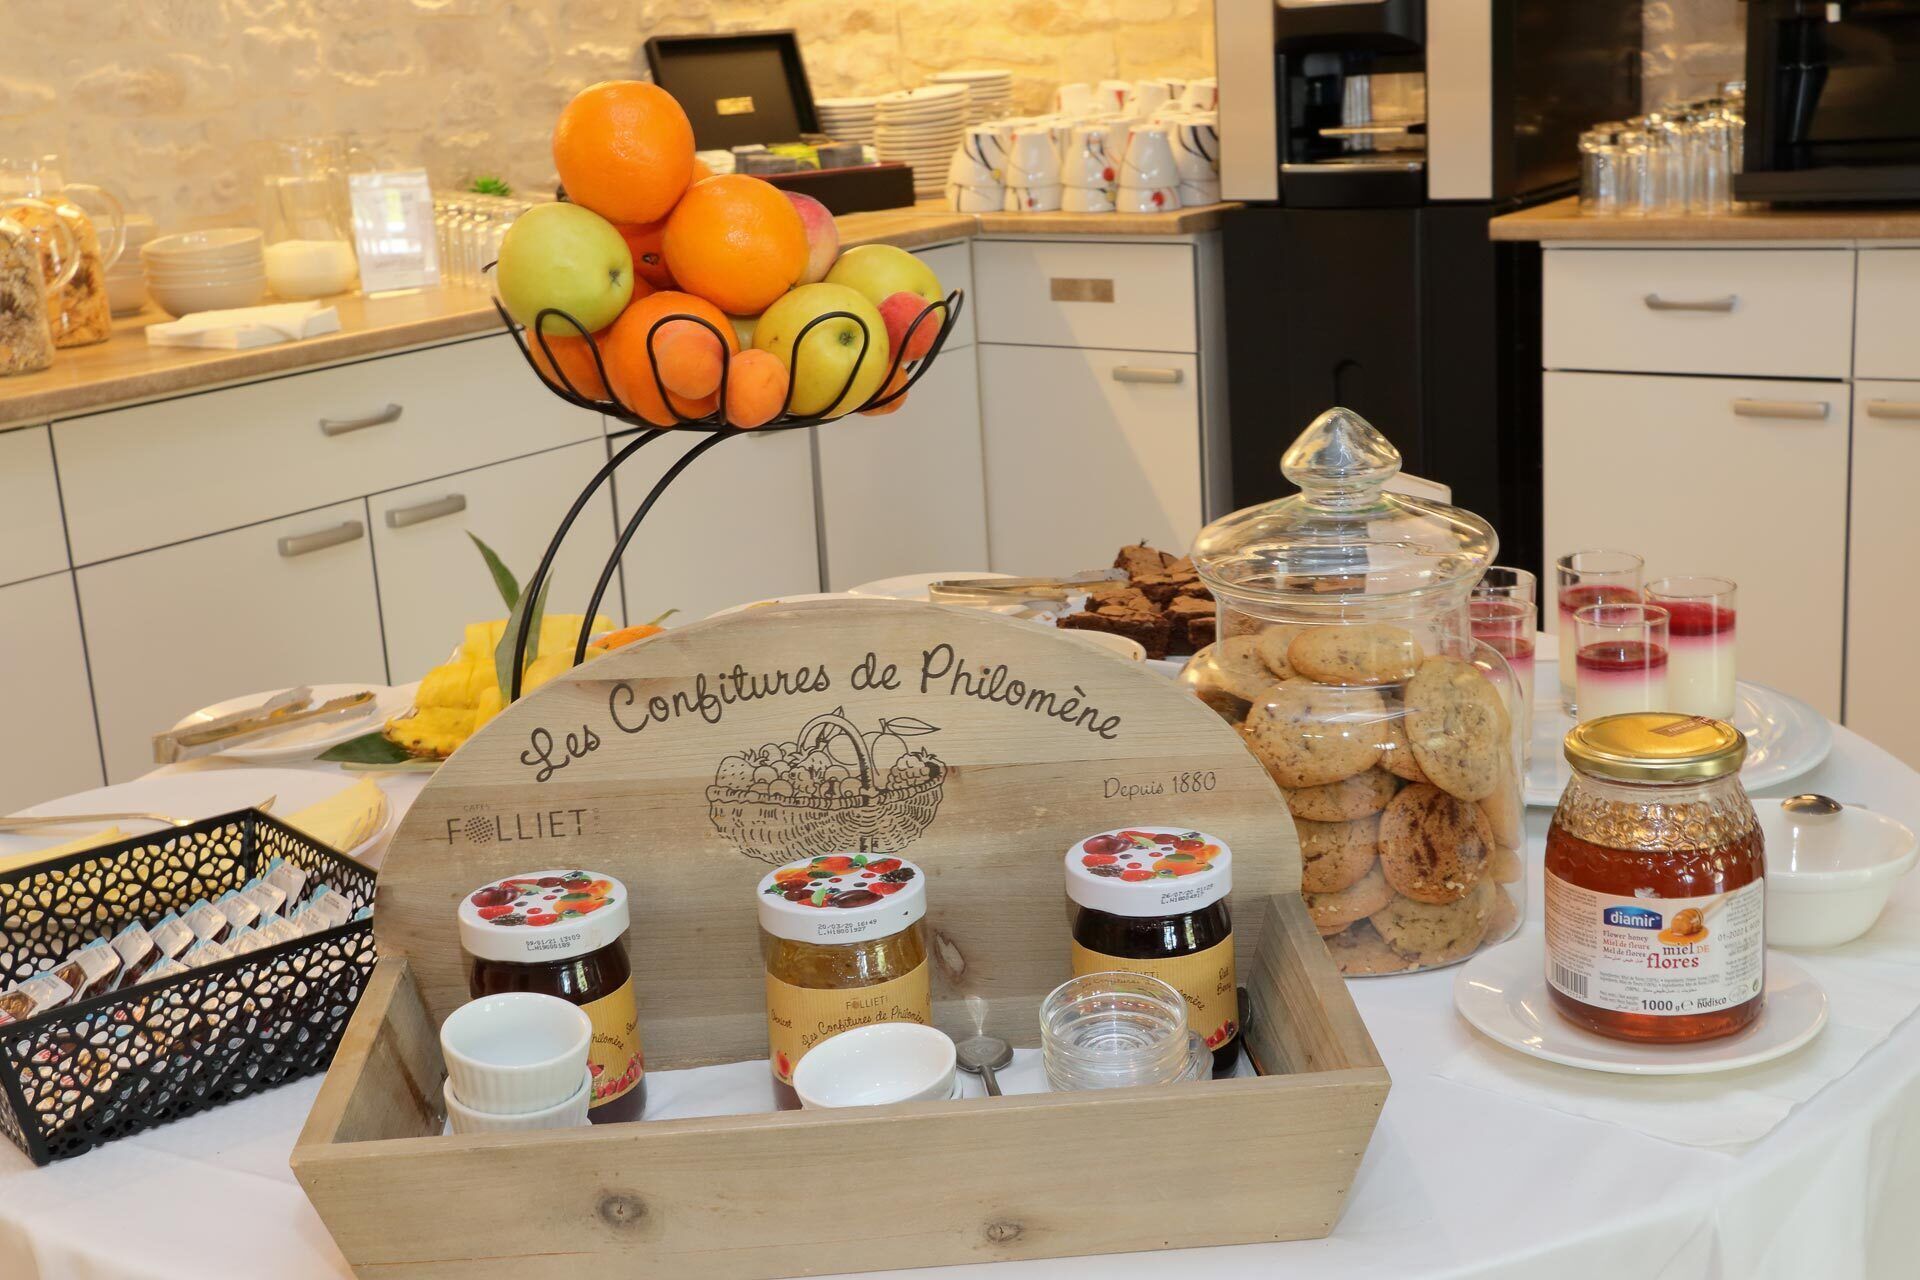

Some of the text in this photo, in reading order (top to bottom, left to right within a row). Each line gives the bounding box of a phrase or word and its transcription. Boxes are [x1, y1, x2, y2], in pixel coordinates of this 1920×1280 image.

[521, 643, 1122, 783] Les Confitures de Philomène
[1103, 771, 1216, 801] Depuis 1880
[1610, 911, 1656, 927] diamir
[1603, 930, 1649, 943] Flower honey
[1603, 938, 1618, 947] Miel
[1628, 942, 1650, 950] fleurs
[1603, 946, 1615, 954] Mel
[1626, 949, 1647, 958] flores
[1663, 942, 1710, 956] miel DE
[1647, 953, 1700, 969] flores
[1641, 1000, 1673, 1011] 1000
[818, 1015, 872, 1035] Confitures
[876, 1010, 889, 1020] de
[591, 1031, 625, 1051] hilomène
